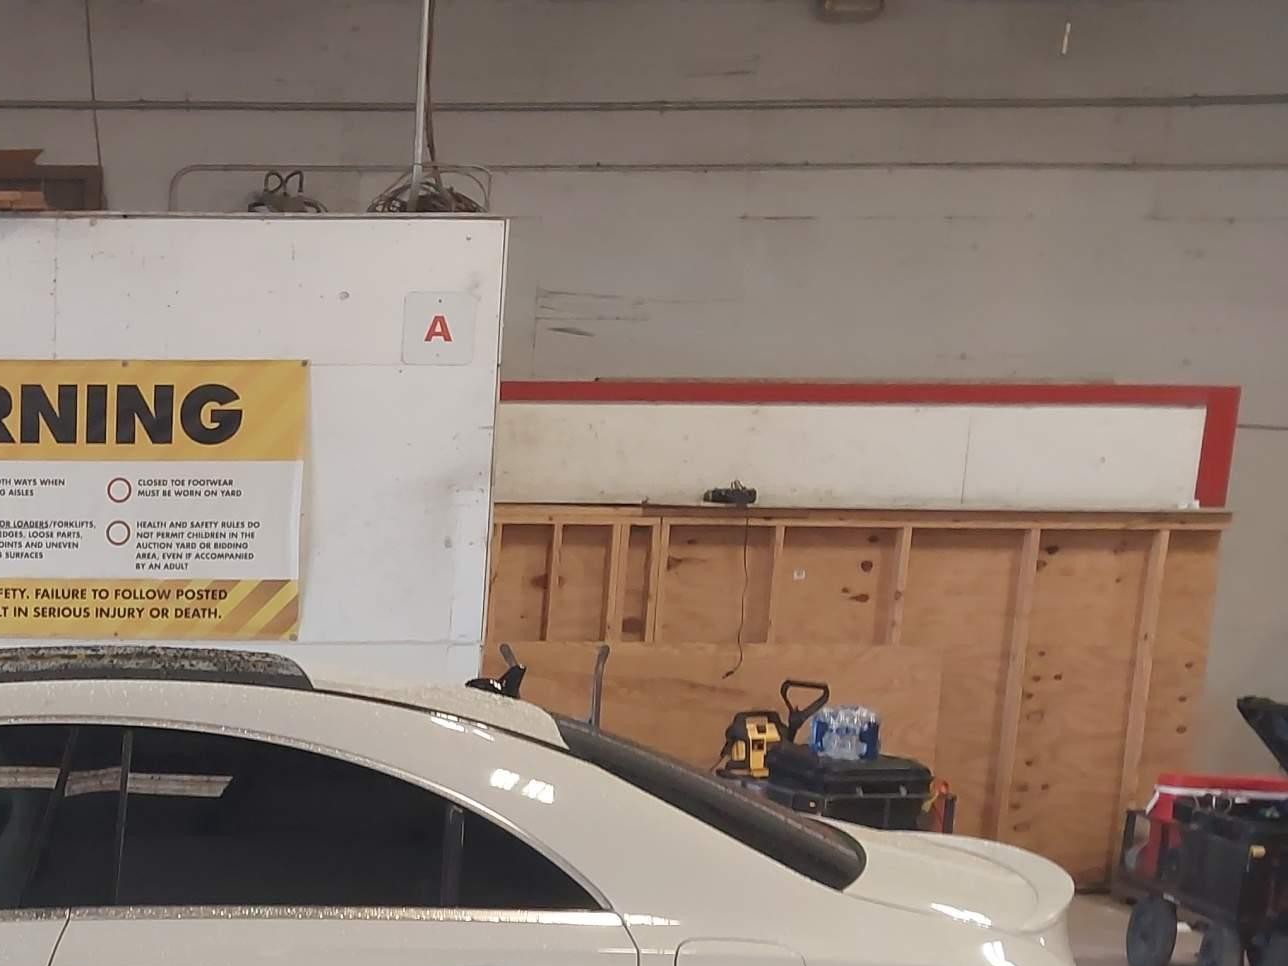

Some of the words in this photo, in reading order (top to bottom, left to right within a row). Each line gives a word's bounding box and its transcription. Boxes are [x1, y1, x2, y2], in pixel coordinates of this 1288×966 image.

[424, 316, 452, 342] A
[35, 588, 87, 599] FAILURE
[91, 589, 109, 600] TO
[115, 589, 171, 600] FOLLOW
[176, 589, 228, 600] POSTED
[13, 606, 28, 617] IN
[33, 607, 90, 618] SERIOUS
[96, 607, 144, 618] INJURY
[149, 607, 169, 618] OR
[175, 608, 222, 619] DEATH.
